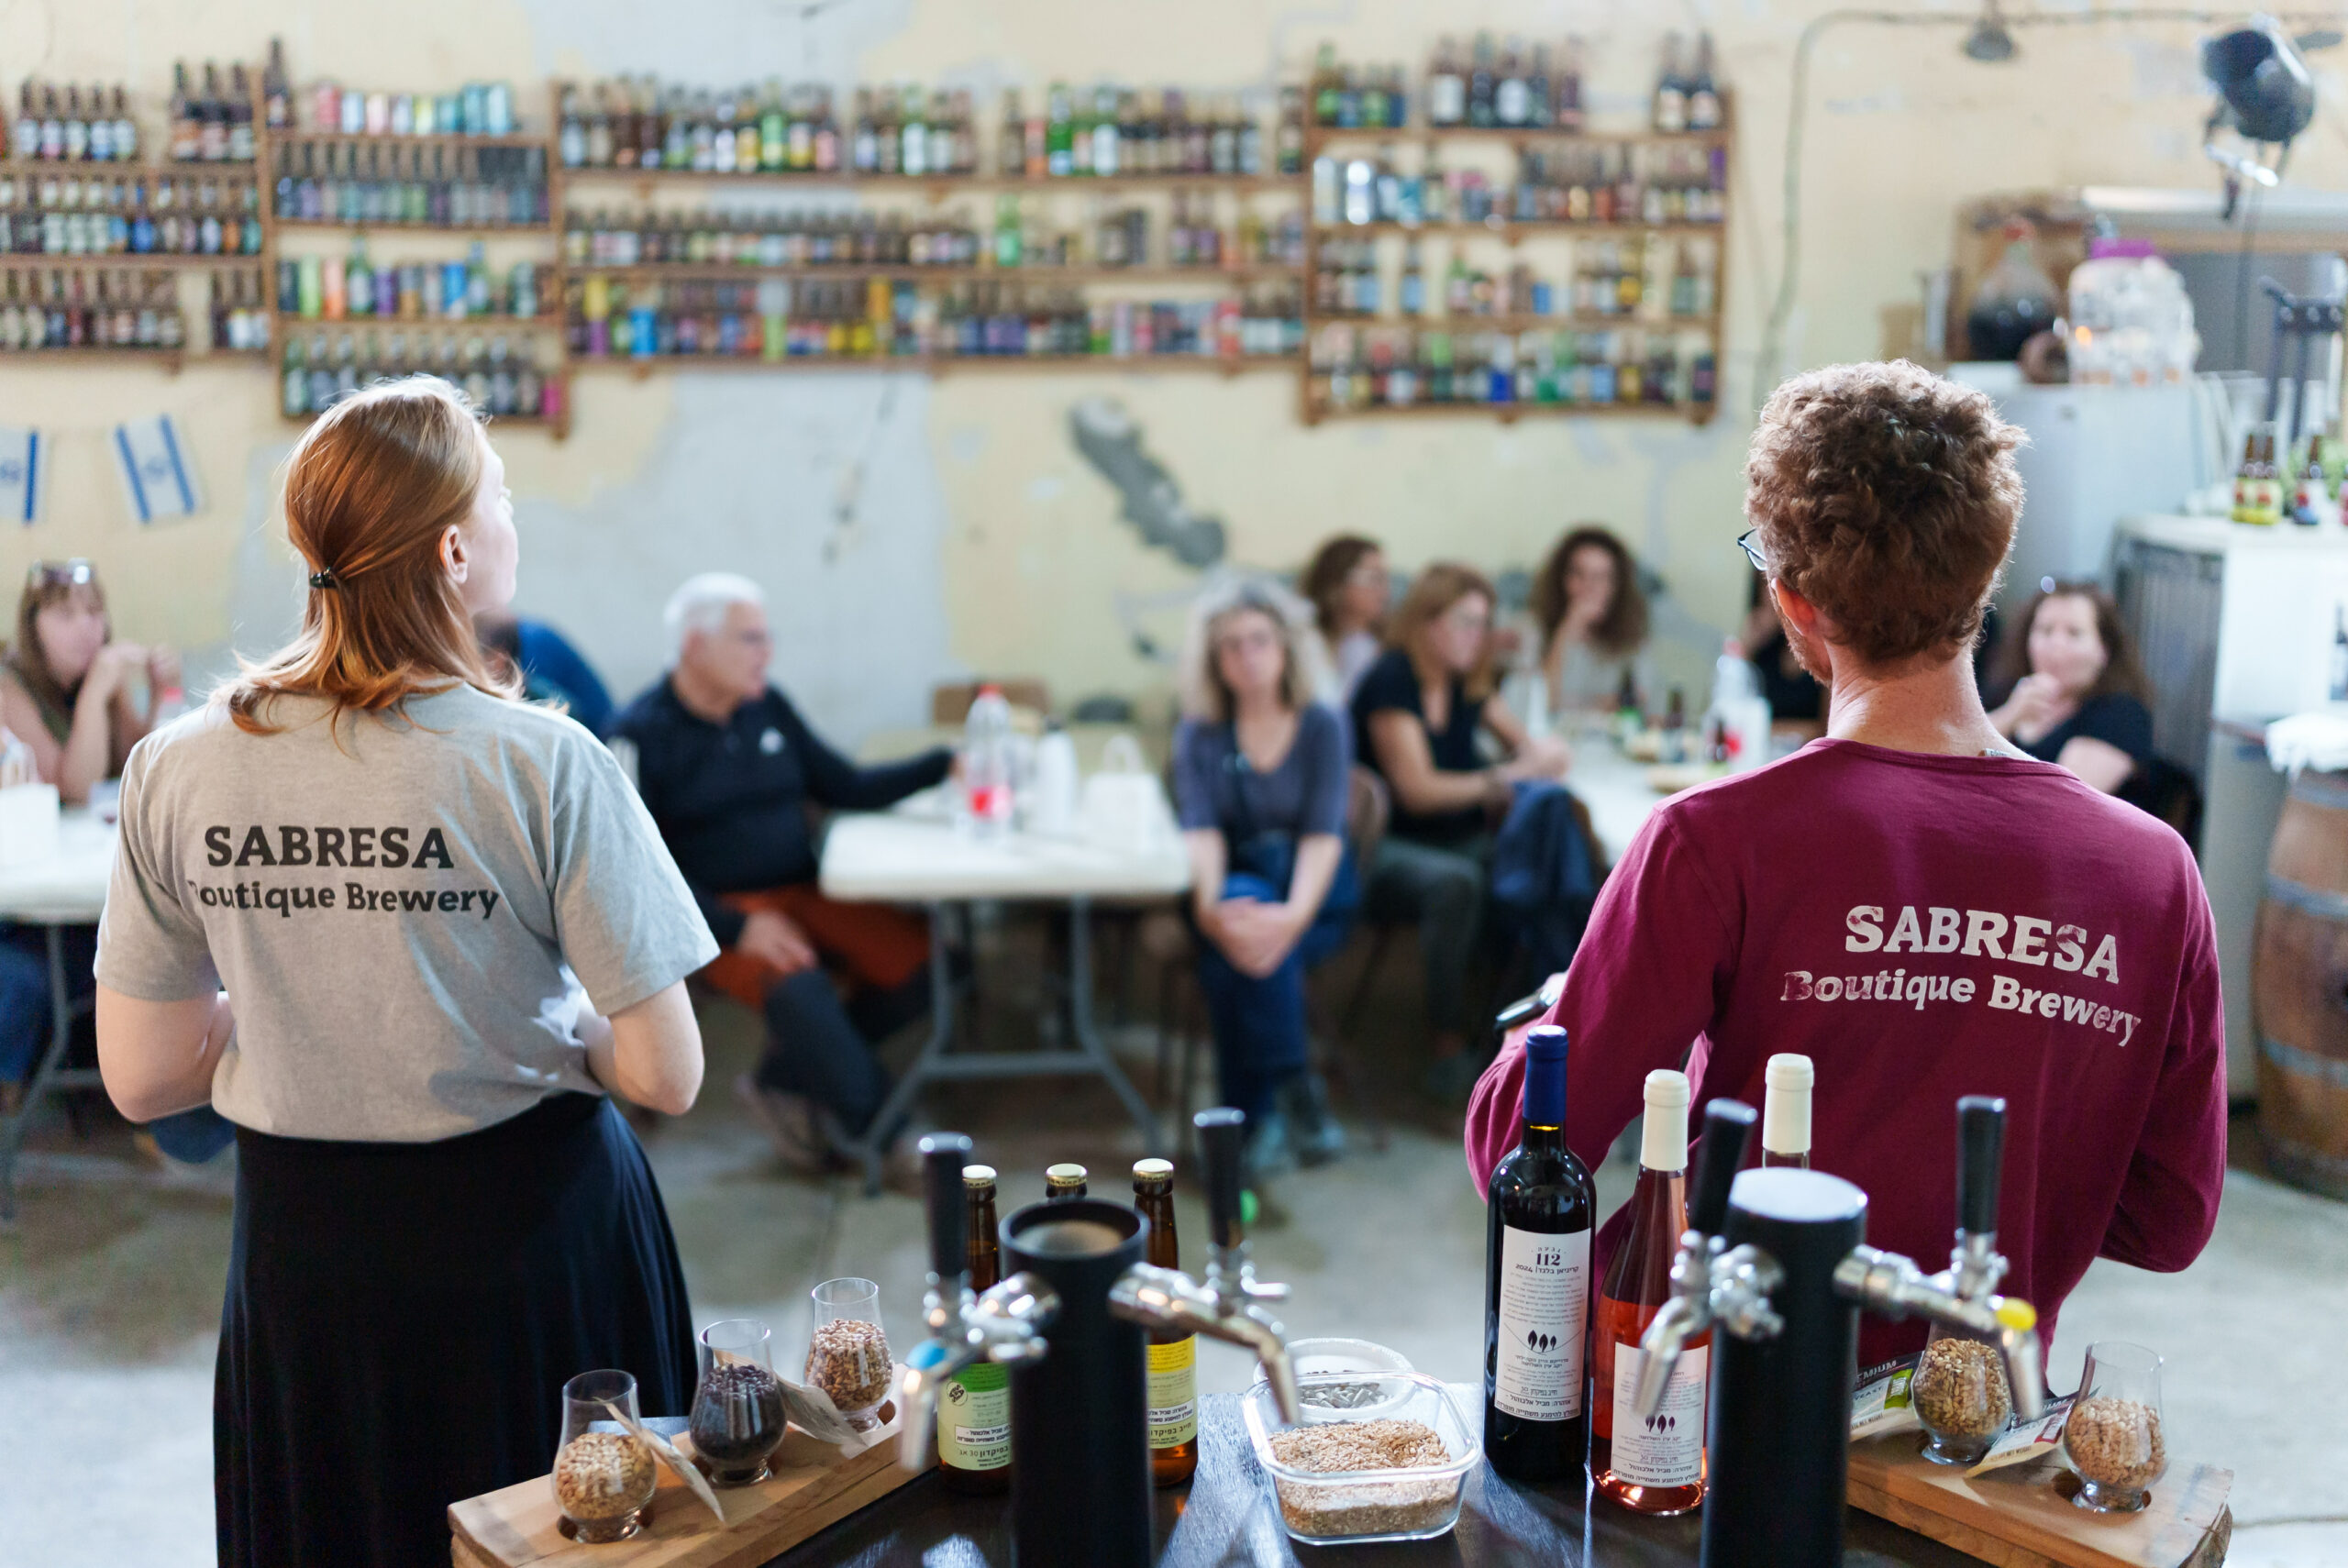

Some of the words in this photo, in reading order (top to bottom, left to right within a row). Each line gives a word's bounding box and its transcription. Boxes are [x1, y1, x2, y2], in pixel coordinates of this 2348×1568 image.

[205, 824, 454, 869] SABRESA
[346, 881, 500, 920] Brewery
[1844, 904, 2120, 985] SABRESA
[1779, 968, 1976, 1011] Boutique
[1987, 975, 2142, 1048] Brewery
[1515, 1264, 1534, 1274] 2024
[1536, 1253, 1561, 1266] 112
[1857, 1359, 1897, 1385] EMIUM
